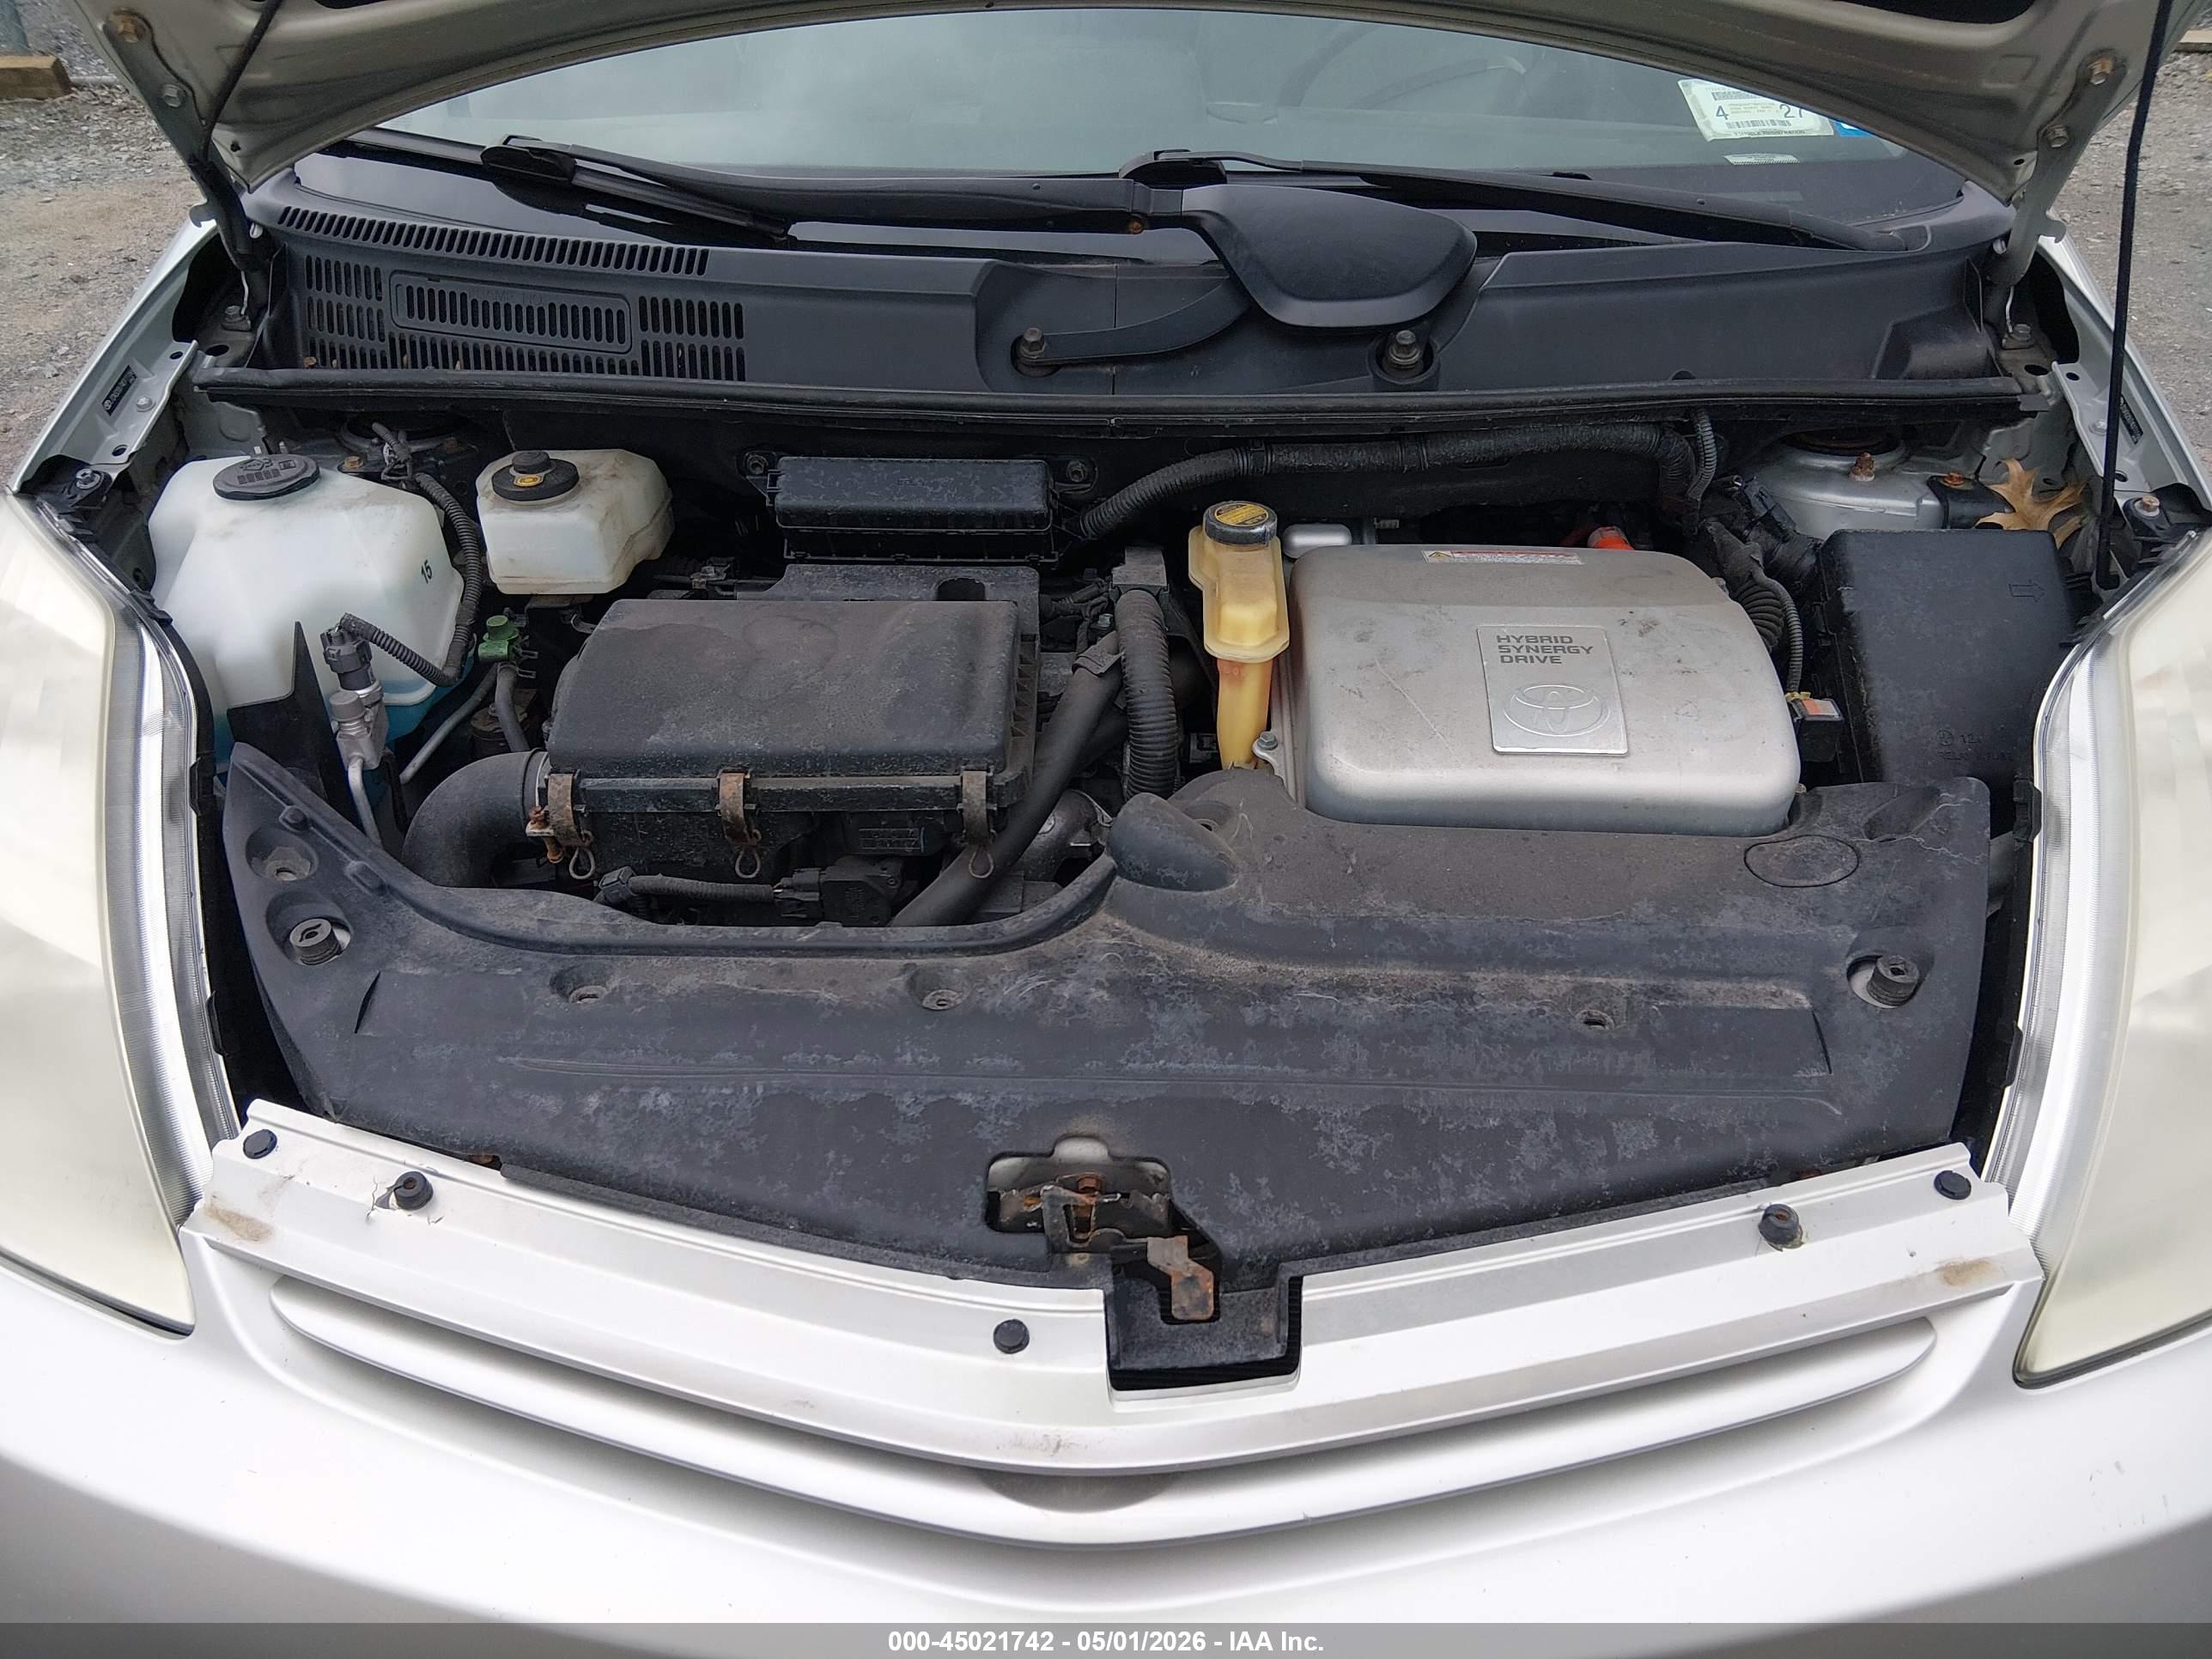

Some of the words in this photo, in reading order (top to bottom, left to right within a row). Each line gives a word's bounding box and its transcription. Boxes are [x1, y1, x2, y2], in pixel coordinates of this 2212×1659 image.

[1716, 106, 1729, 120] 4
[421, 559, 433, 585] 15
[1497, 635, 1573, 644] HYBRID
[1498, 645, 1594, 654] SYNERGY
[1500, 655, 1562, 665] DRIVE
